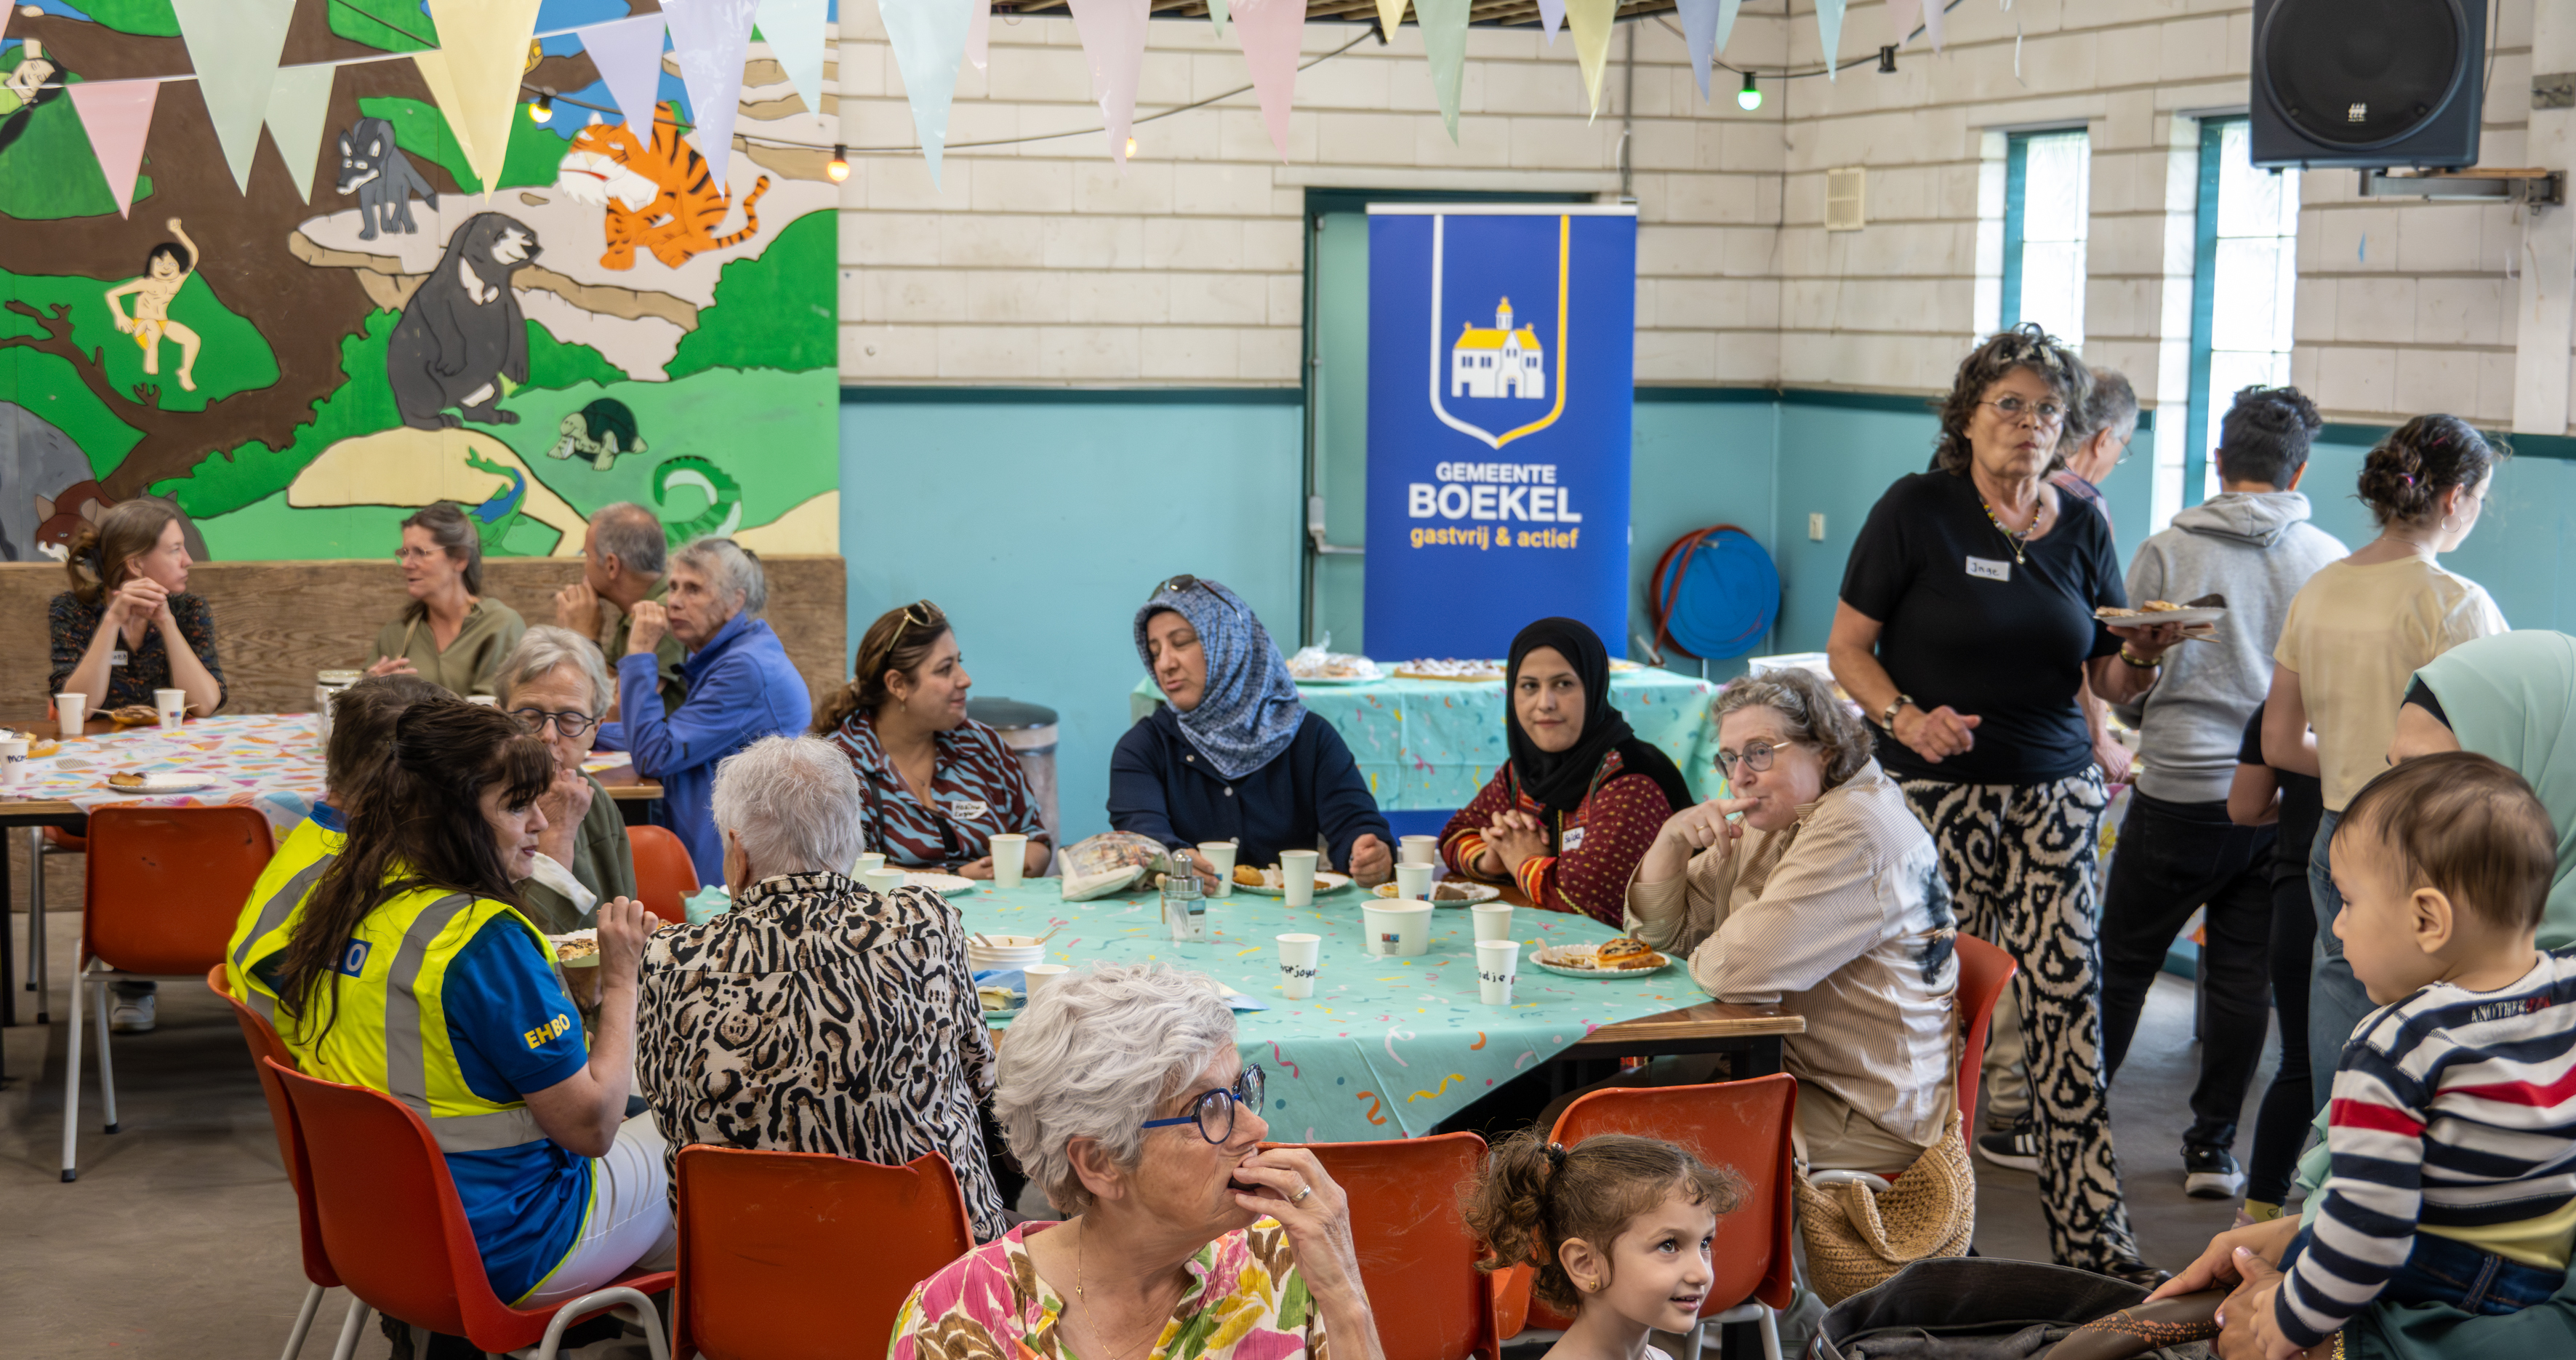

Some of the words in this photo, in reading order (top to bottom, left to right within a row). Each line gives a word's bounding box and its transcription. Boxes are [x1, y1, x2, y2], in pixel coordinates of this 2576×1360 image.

[1436, 462, 1557, 484] GEMEENTE
[1408, 483, 1582, 522] BOEKEL
[1411, 526, 1489, 551] gastvrij
[1495, 527, 1511, 546] &
[1517, 527, 1579, 549] actief
[2471, 999, 2526, 1023] ANOTHER
[524, 1013, 571, 1049] EHBO
